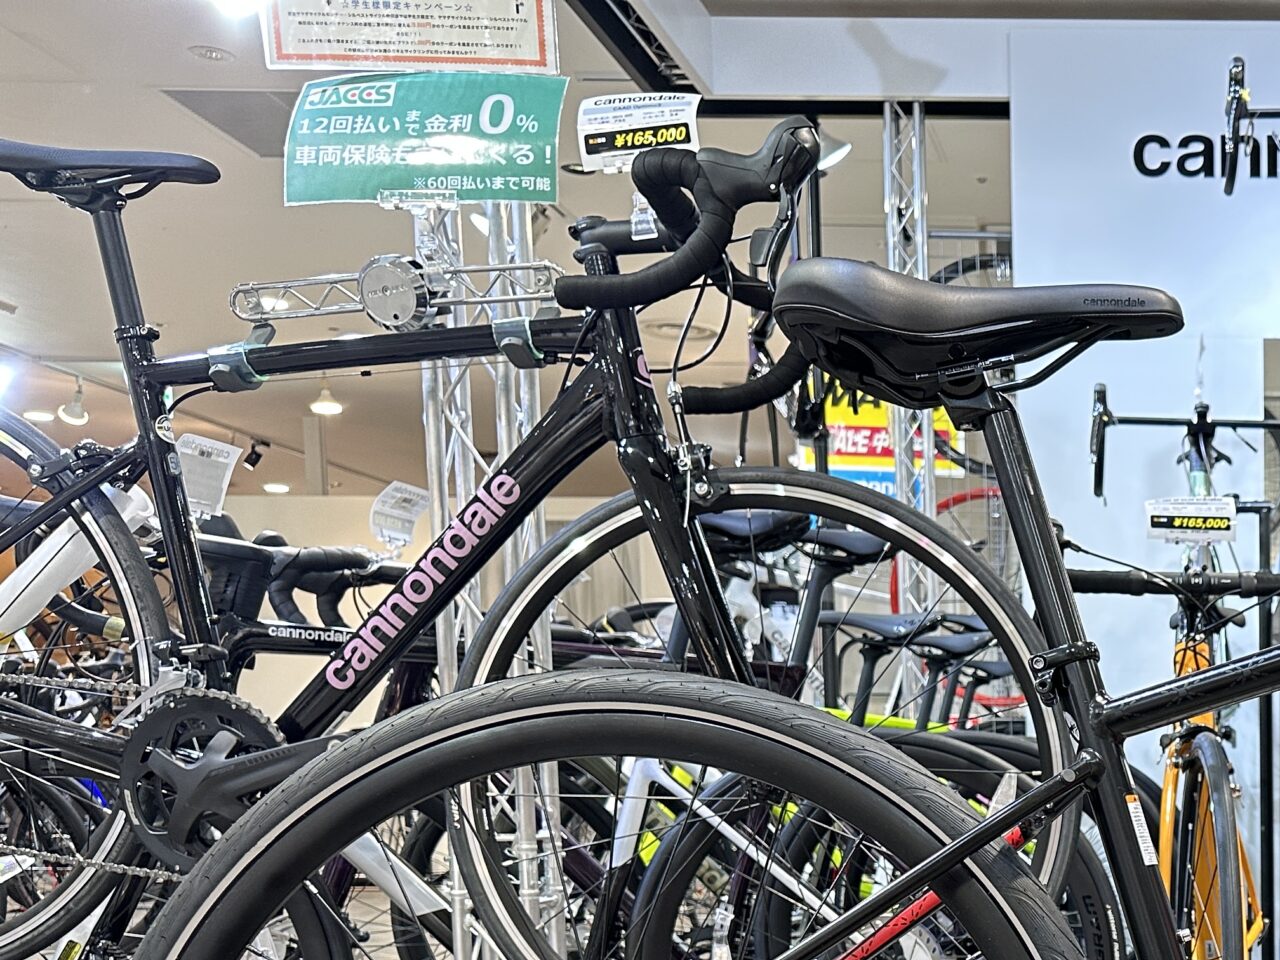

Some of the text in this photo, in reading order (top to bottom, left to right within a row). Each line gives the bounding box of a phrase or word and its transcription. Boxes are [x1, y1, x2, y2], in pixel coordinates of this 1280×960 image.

[307, 84, 394, 107] JACCS
[594, 94, 687, 106] cannondale
[614, 126, 687, 148] ¥165,000
[413, 175, 551, 191] ※60回払いまで可能
[1083, 296, 1147, 308] cannondale
[1173, 517, 1229, 530] ¥165,000
[325, 474, 522, 691] cannondale
